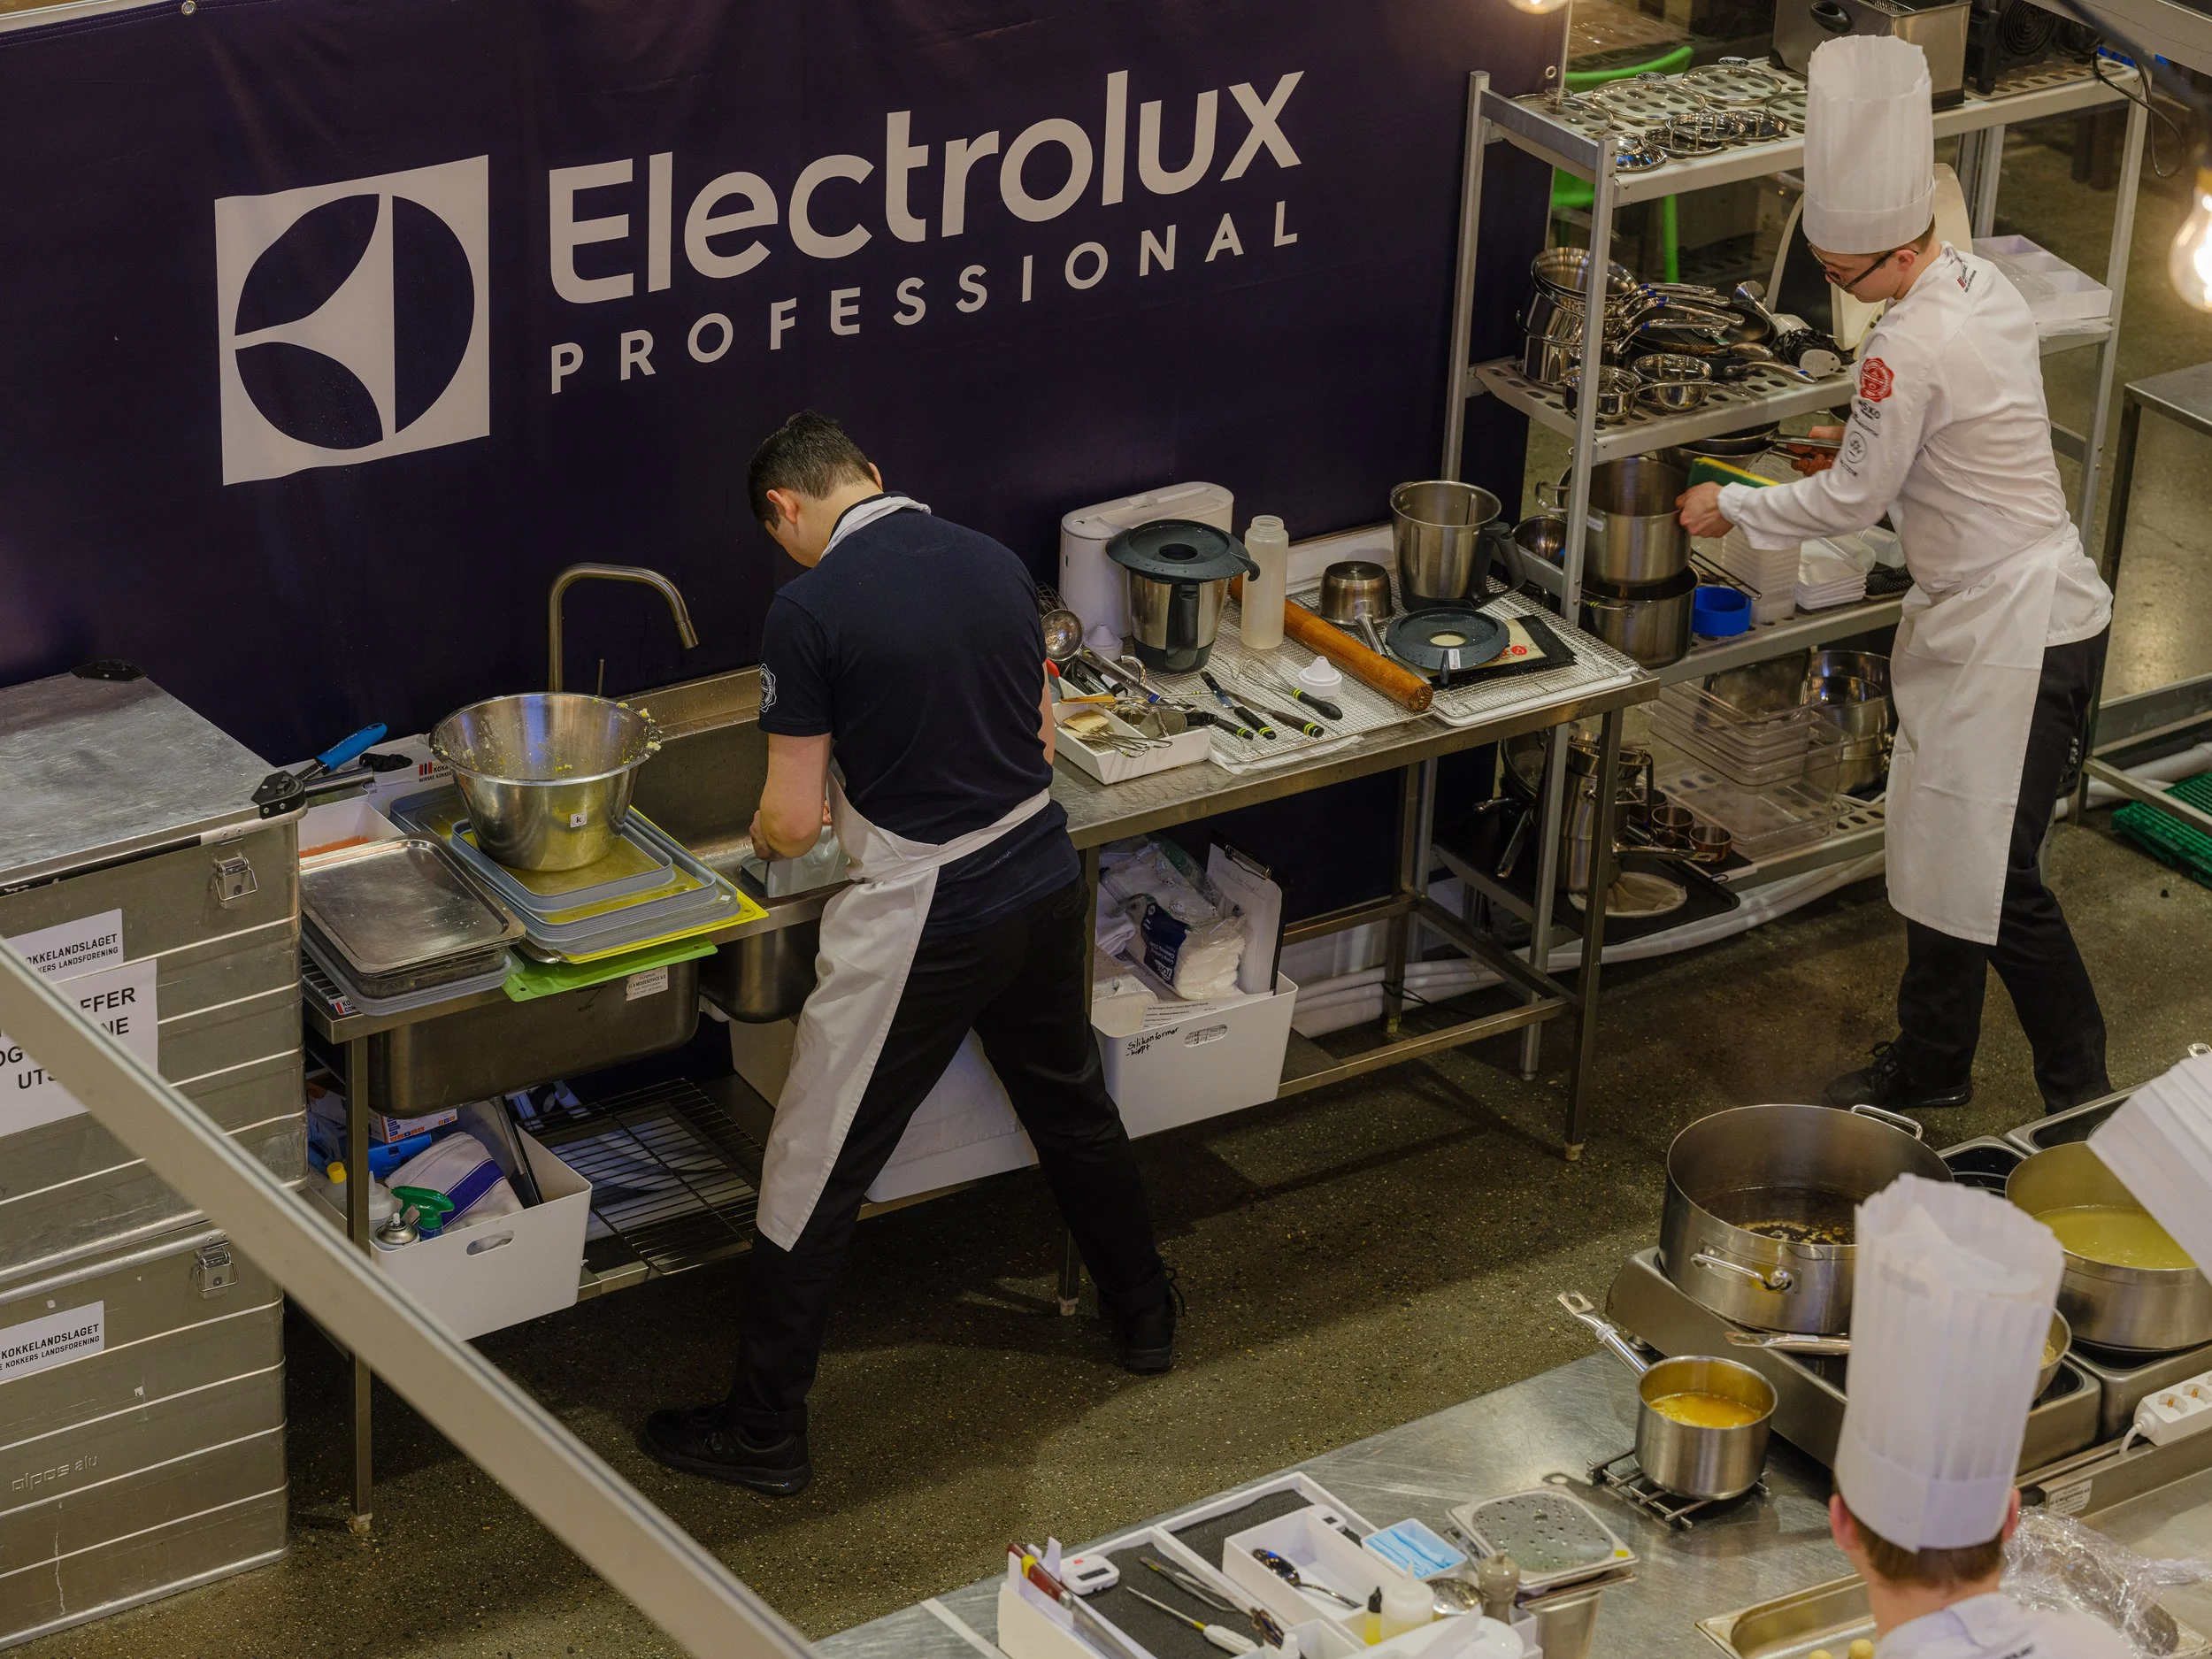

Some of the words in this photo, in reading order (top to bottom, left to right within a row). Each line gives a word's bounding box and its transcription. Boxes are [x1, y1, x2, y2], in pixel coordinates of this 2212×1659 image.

[549, 70, 1304, 304] Electrolux
[551, 200, 1298, 394] PROFESSIONAL
[58, 947, 119, 969] LANDSFORENING
[1, 1324, 99, 1360] KOKKELANDSLAGET
[5, 1354, 39, 1369] KOKKERS
[41, 1335, 100, 1358] LANDSFORENING
